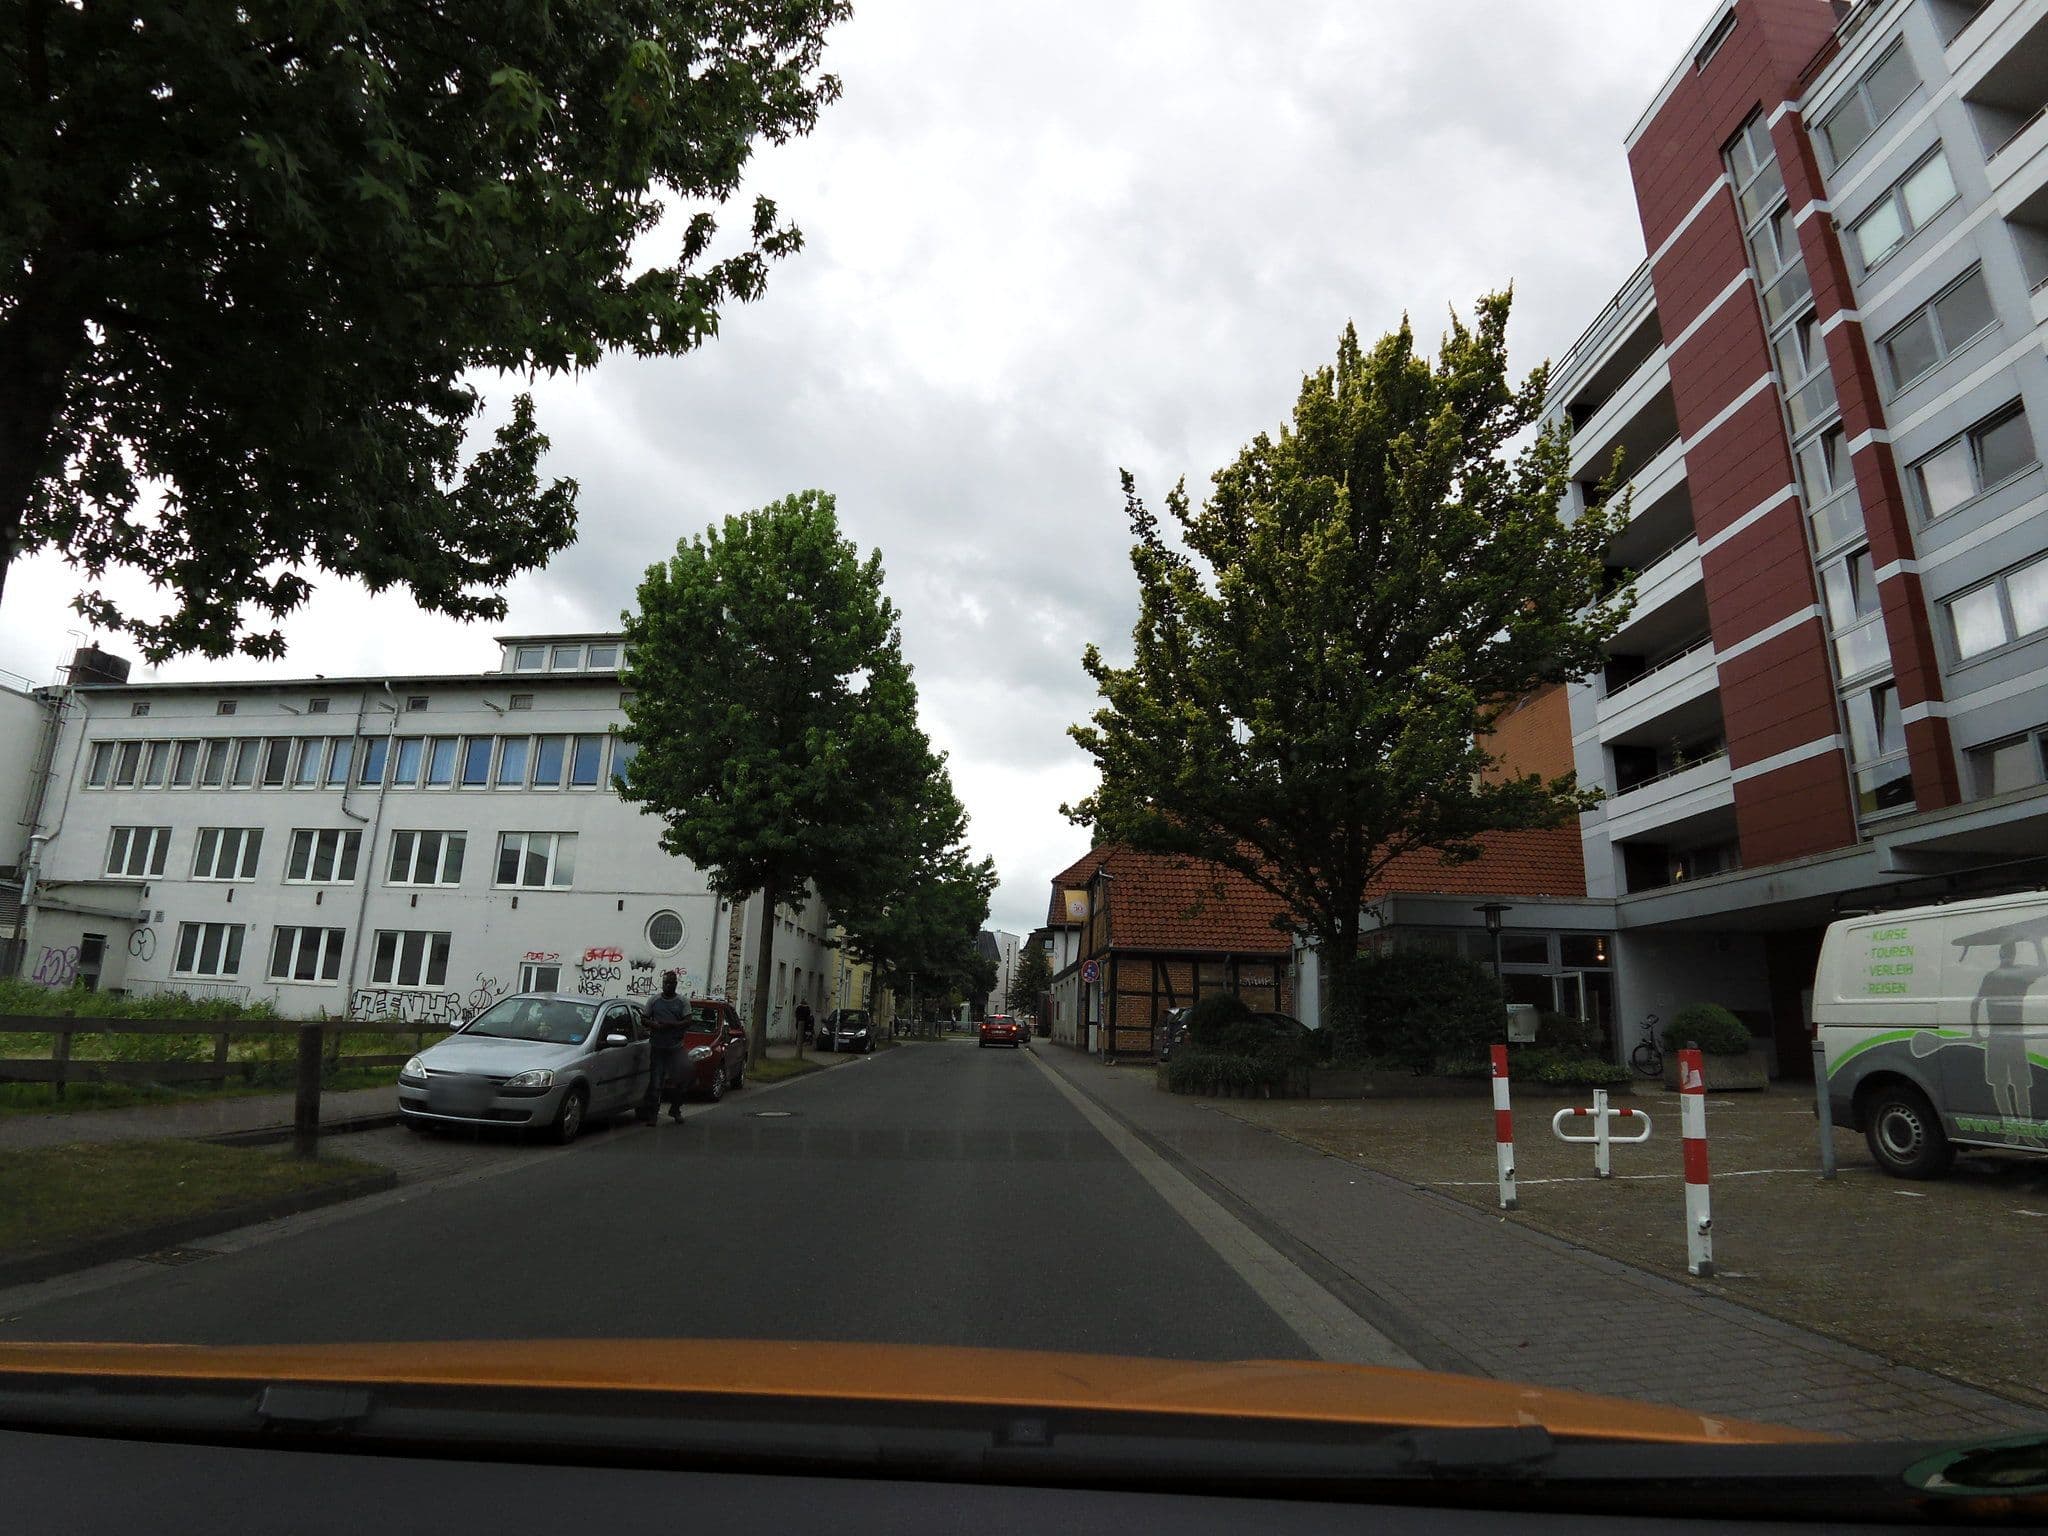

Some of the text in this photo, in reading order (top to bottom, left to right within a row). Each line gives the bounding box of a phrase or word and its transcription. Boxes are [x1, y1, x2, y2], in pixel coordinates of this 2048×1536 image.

[1872, 928, 1908, 941] KURSE
[1871, 945, 1914, 958] TOUREN
[1870, 963, 1914, 977] VERLEIH
[1868, 982, 1906, 994] REISEN
